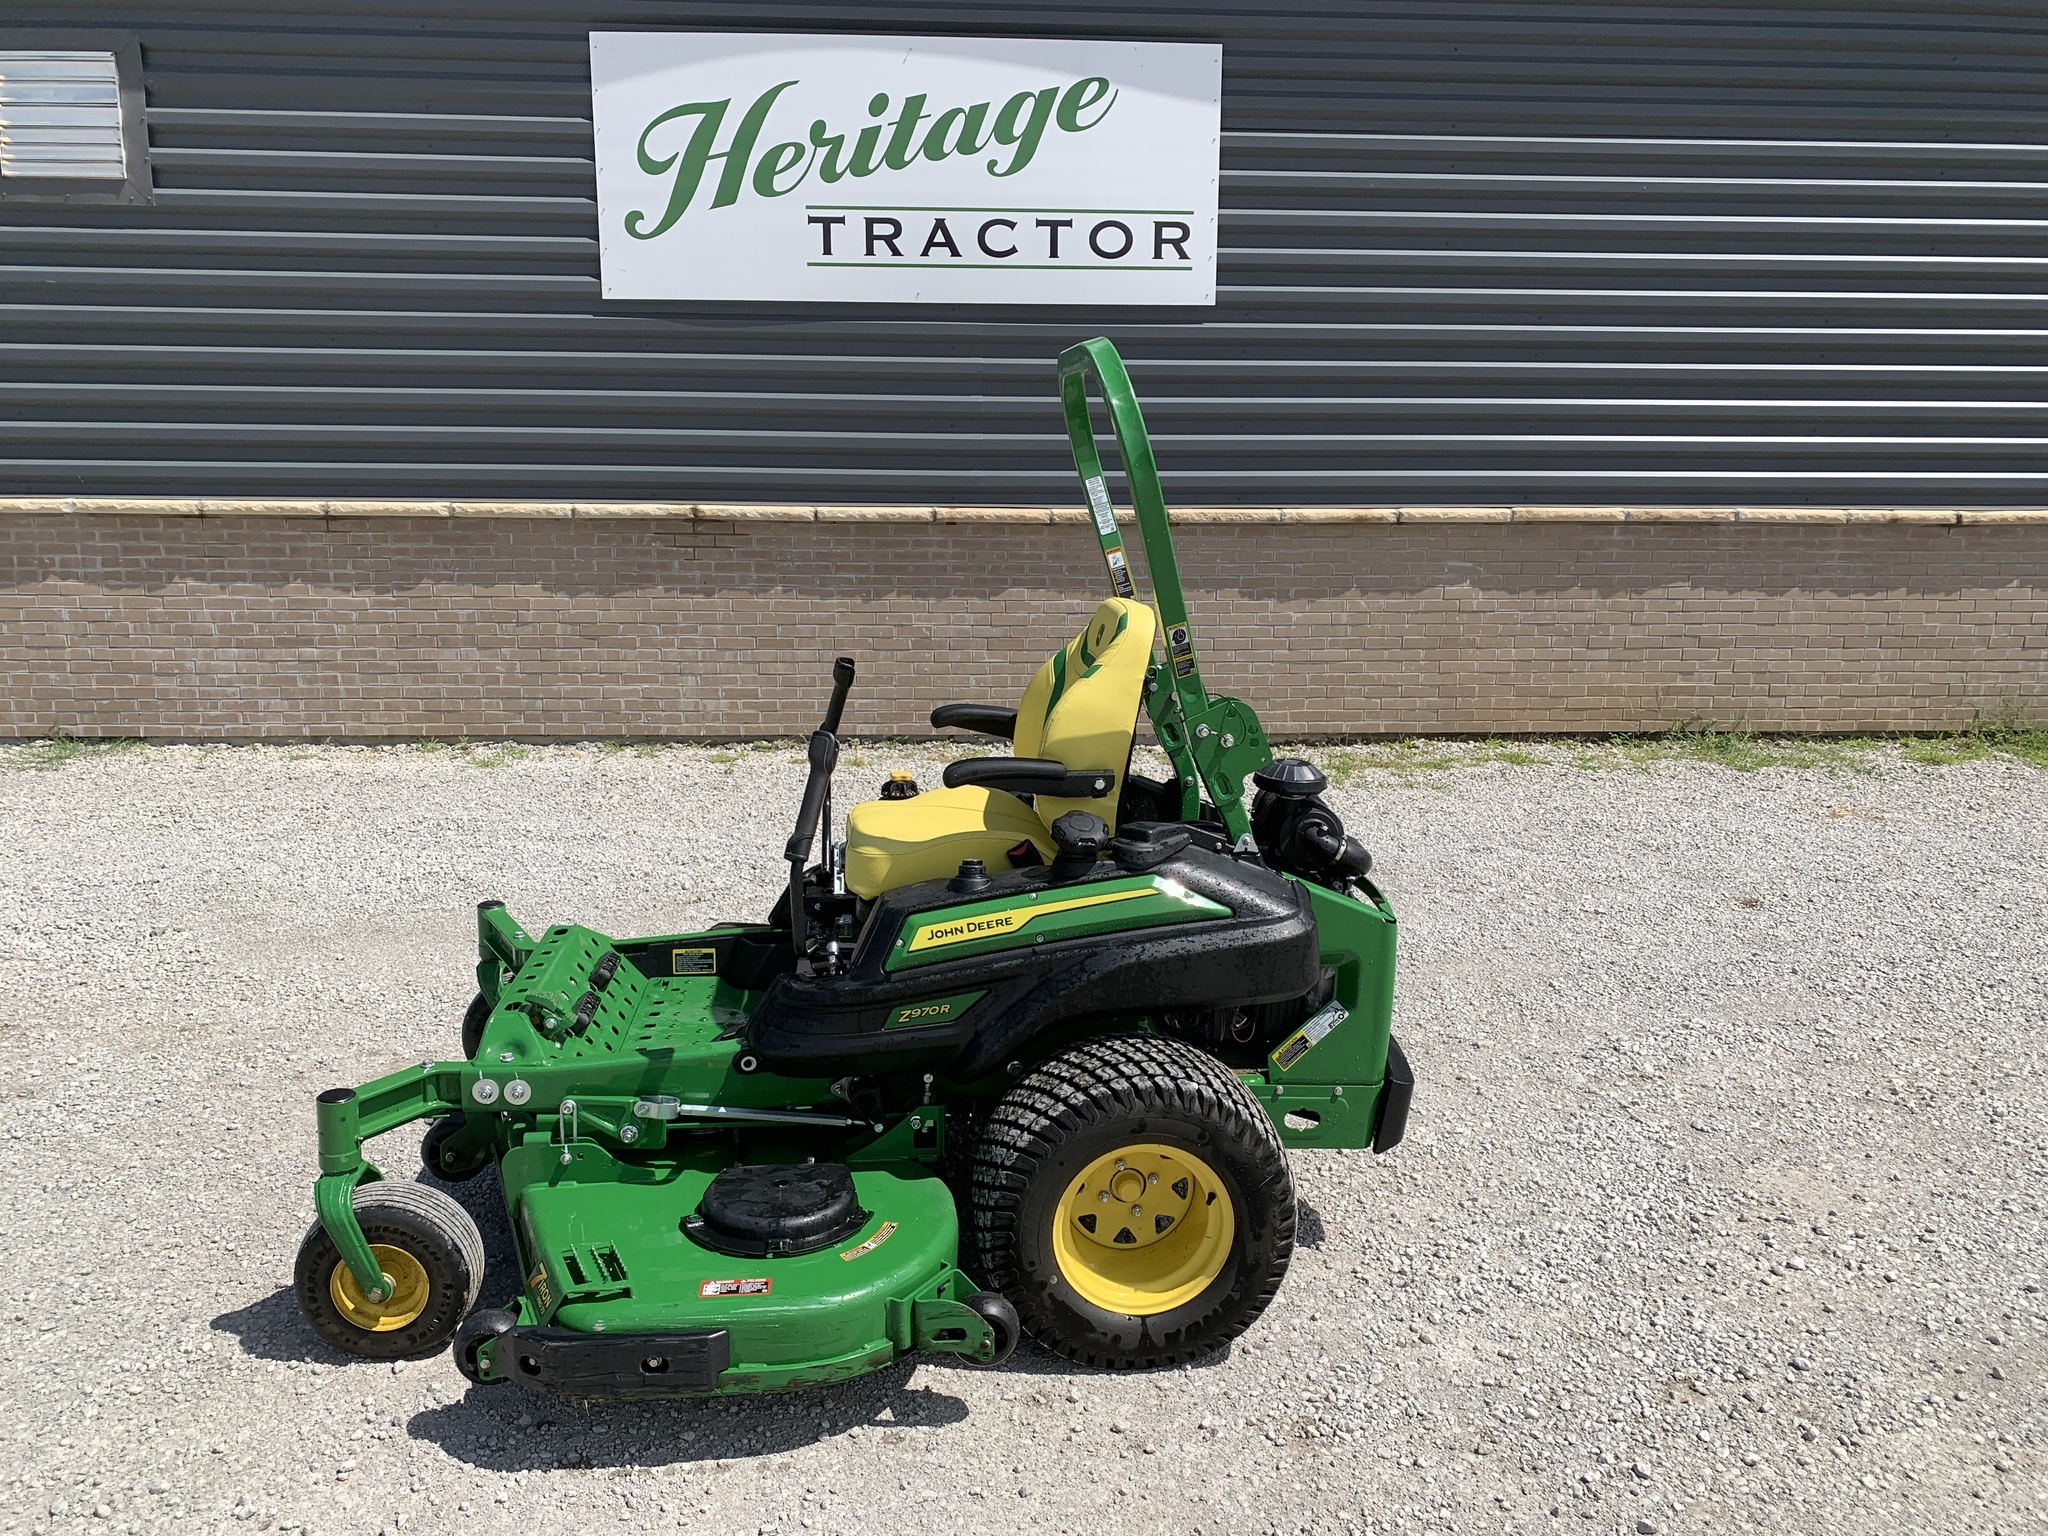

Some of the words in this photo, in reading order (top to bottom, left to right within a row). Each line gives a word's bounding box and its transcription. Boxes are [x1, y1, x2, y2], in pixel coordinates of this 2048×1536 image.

[624, 76, 1119, 240] Heritage
[807, 214, 1192, 261] TRACTOR
[927, 926, 964, 941] JOHN
[966, 917, 1014, 933] DEERE
[898, 1004, 951, 1023] Z970R
